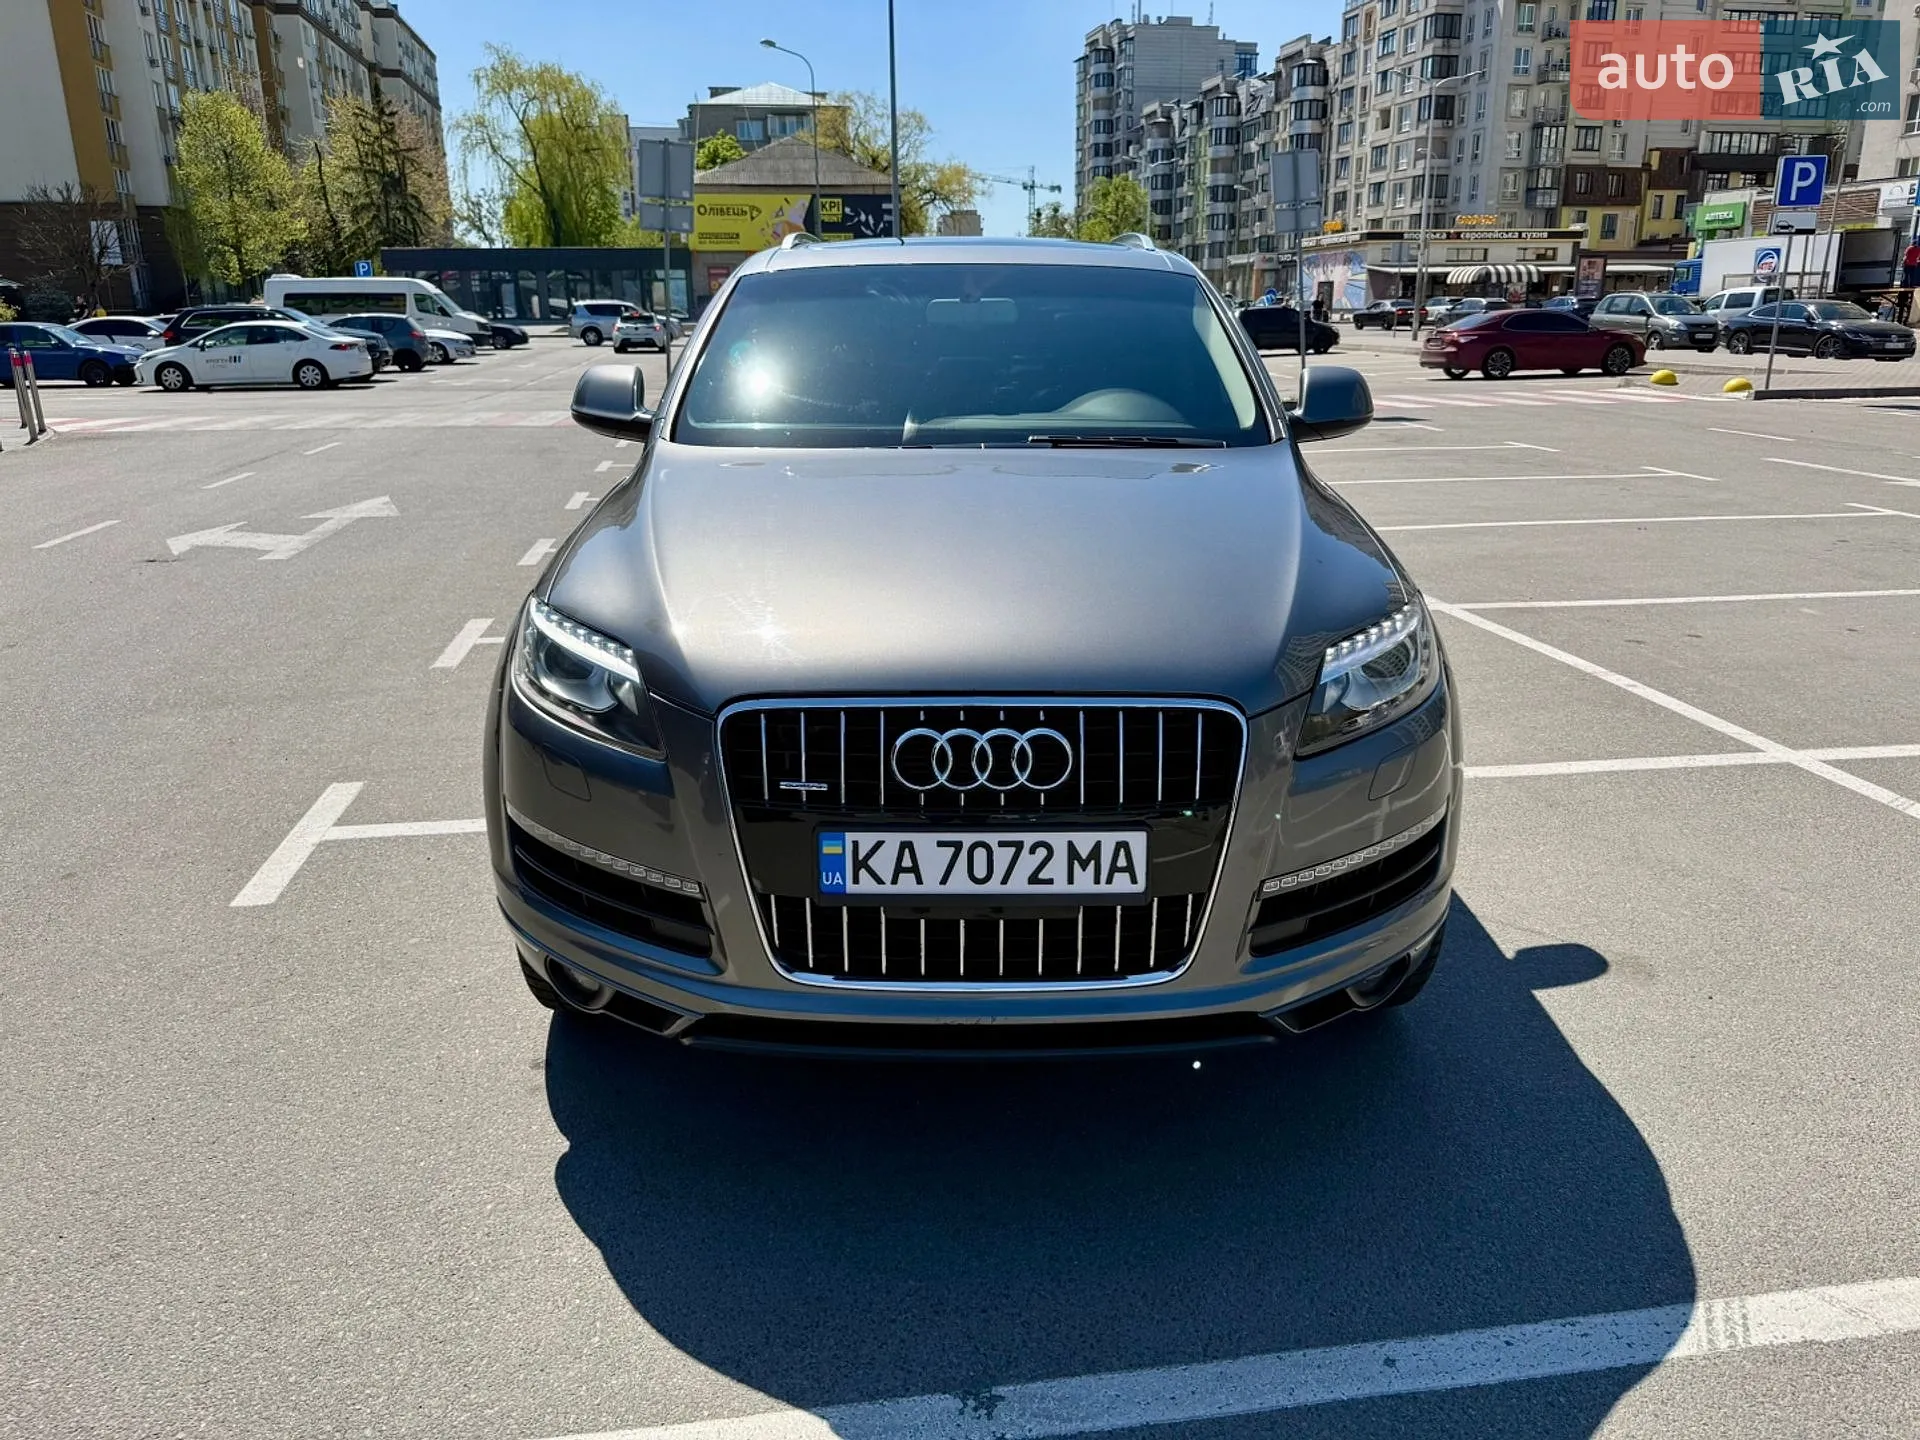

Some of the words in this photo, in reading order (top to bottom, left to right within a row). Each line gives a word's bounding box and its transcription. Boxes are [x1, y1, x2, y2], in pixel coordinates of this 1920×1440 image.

[1790, 161, 1816, 201] P
[1403, 232, 1447, 240] япоська
[1521, 231, 1548, 241] кухня
[359, 262, 369, 276] P
[852, 840, 924, 886] KA
[936, 840, 1055, 886] 7072
[1066, 840, 1139, 886] MA
[822, 871, 844, 886] UA
